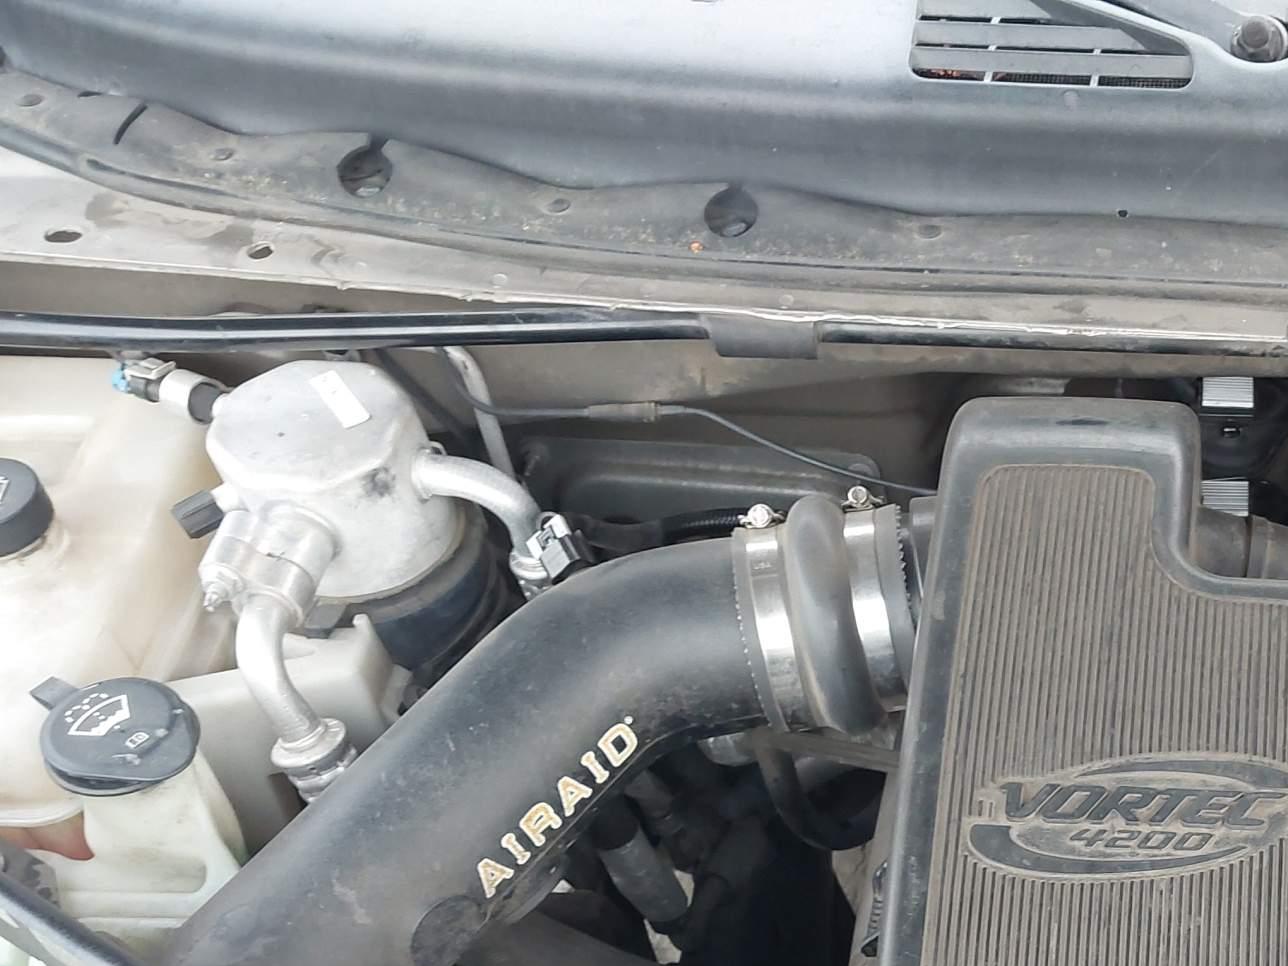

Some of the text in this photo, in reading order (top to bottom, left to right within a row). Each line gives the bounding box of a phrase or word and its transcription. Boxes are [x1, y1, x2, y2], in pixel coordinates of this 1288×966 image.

[475, 722, 640, 899] AIRAID
[1001, 781, 1286, 828] VORTEC
[1068, 829, 1215, 852] 4200
